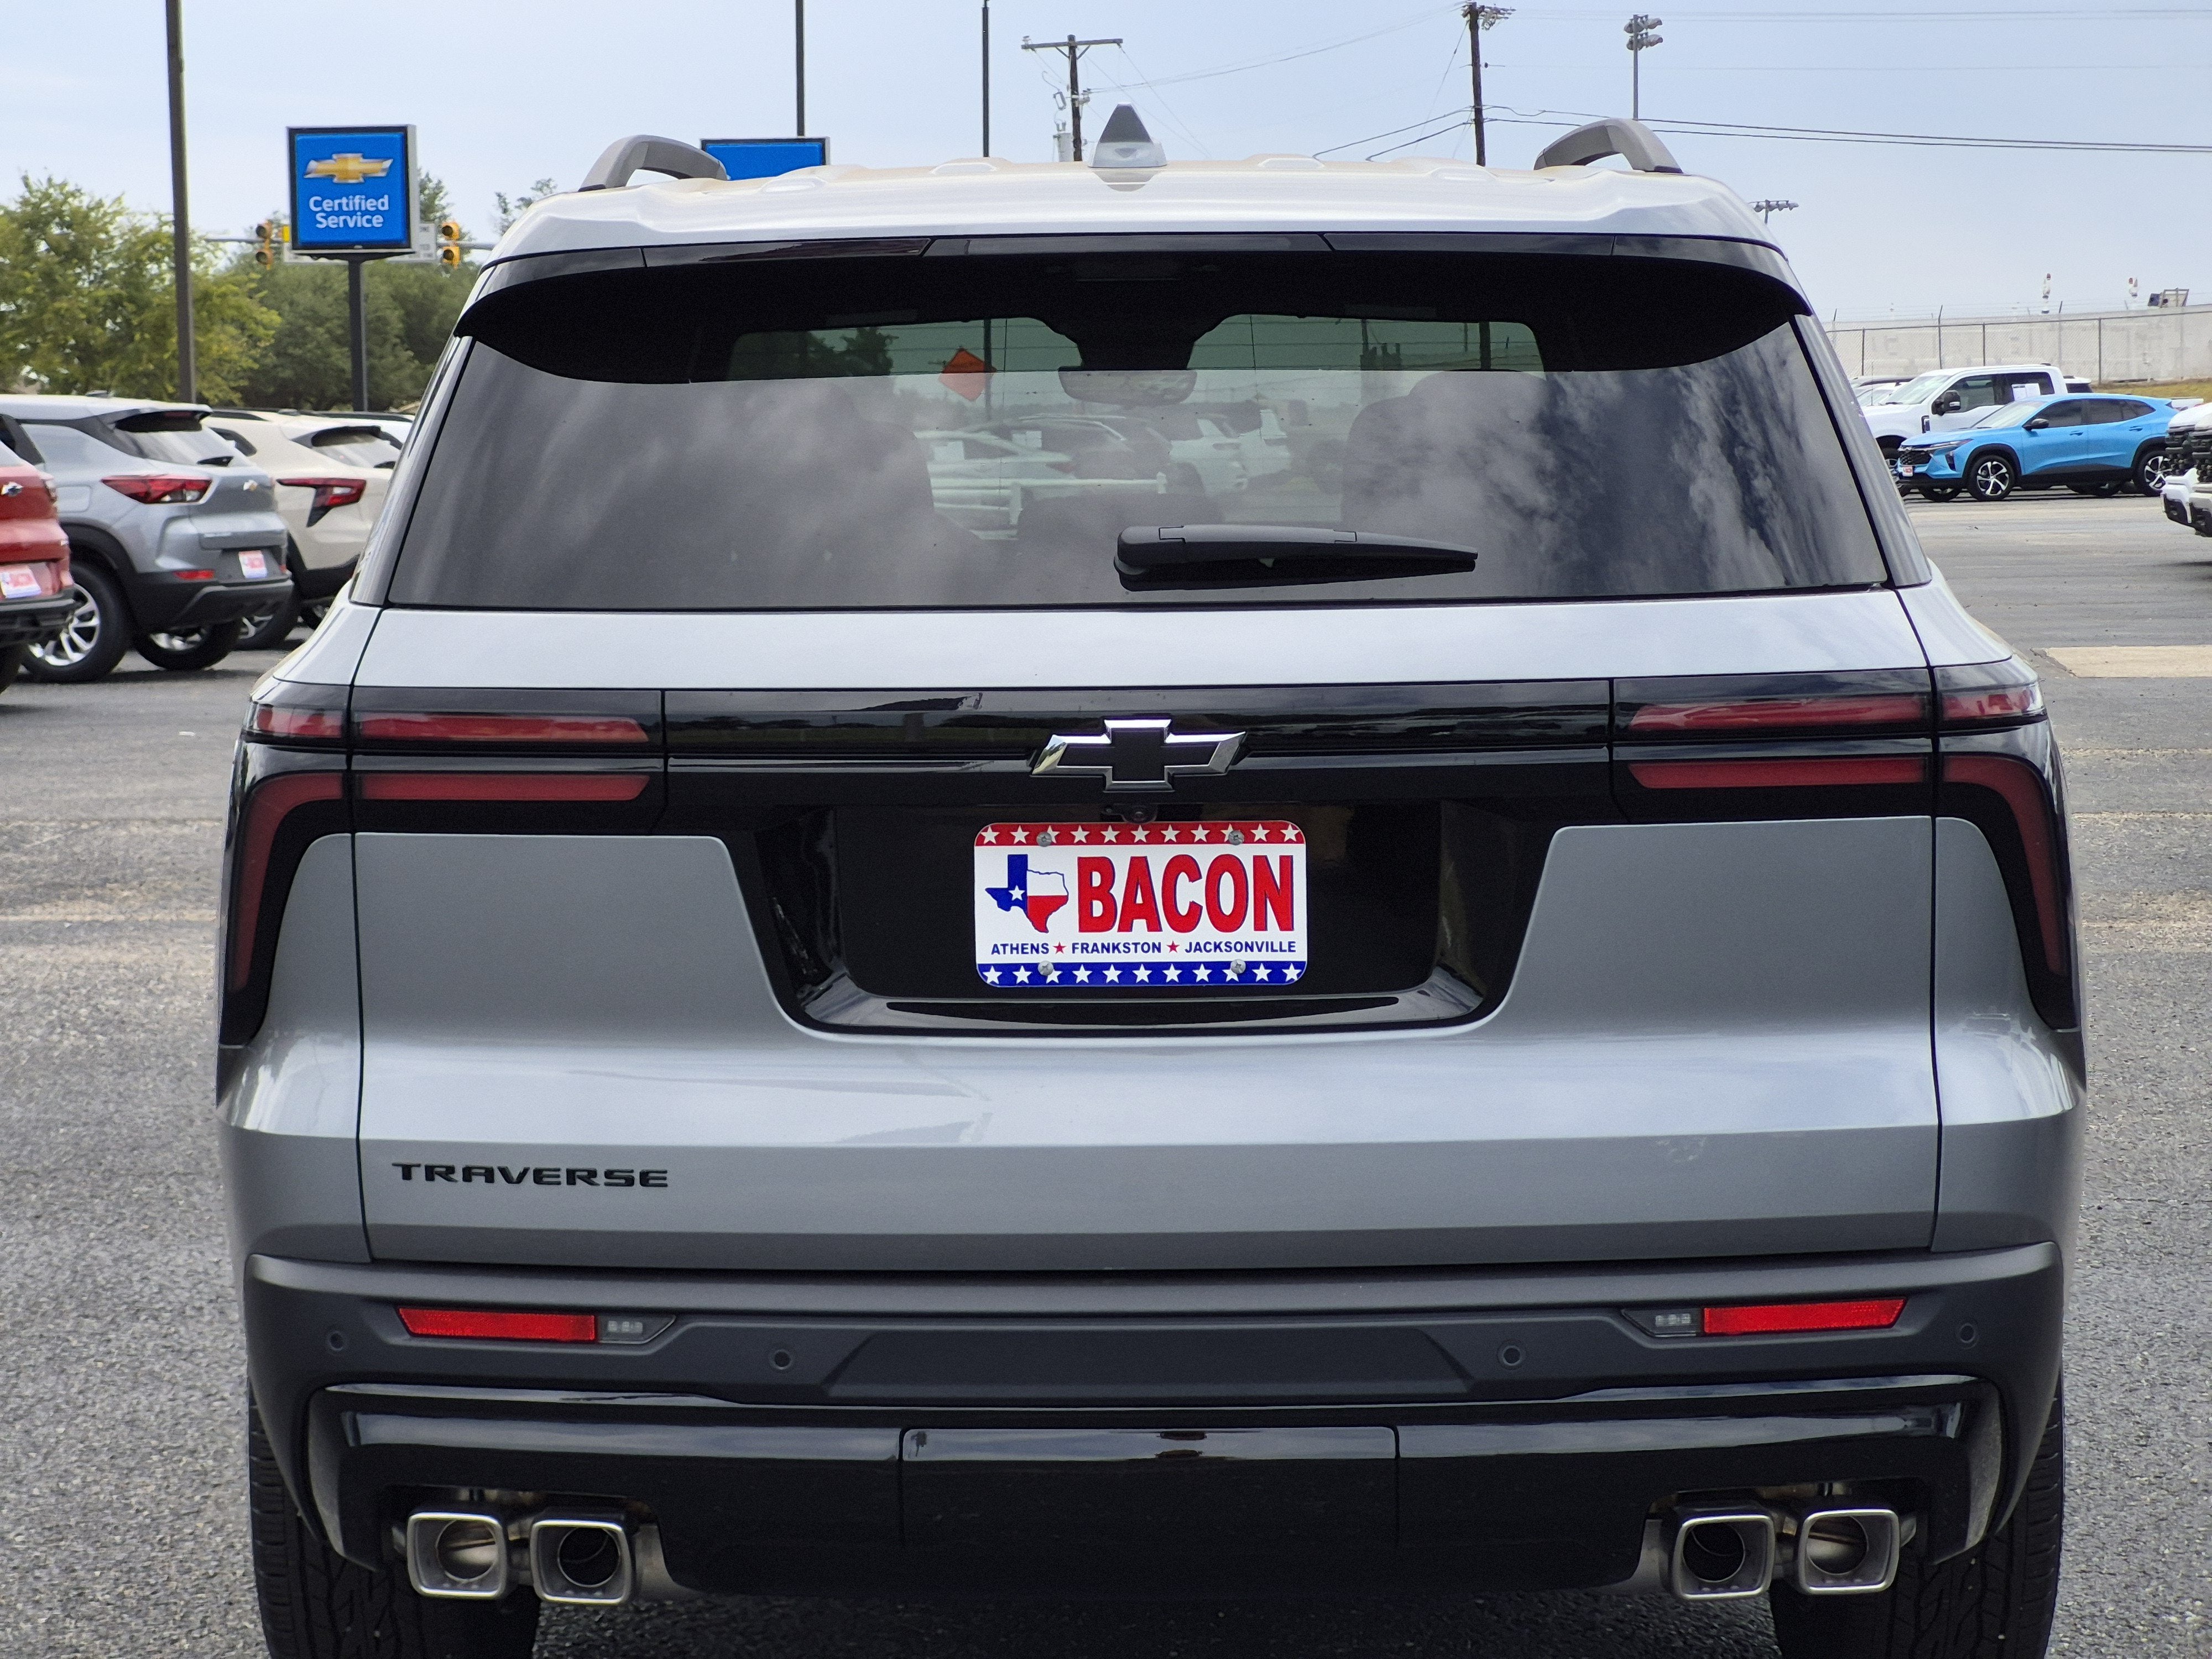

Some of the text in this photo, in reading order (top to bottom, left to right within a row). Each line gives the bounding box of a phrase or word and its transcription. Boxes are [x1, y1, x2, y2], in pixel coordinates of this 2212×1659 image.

[309, 195, 389, 212] Certified
[315, 212, 384, 229] Service
[1077, 853, 1294, 933] BACON
[991, 940, 1296, 955] ATHENS FRANKSTON JACKSONVILLE
[392, 1162, 668, 1188] TRAVERSE
